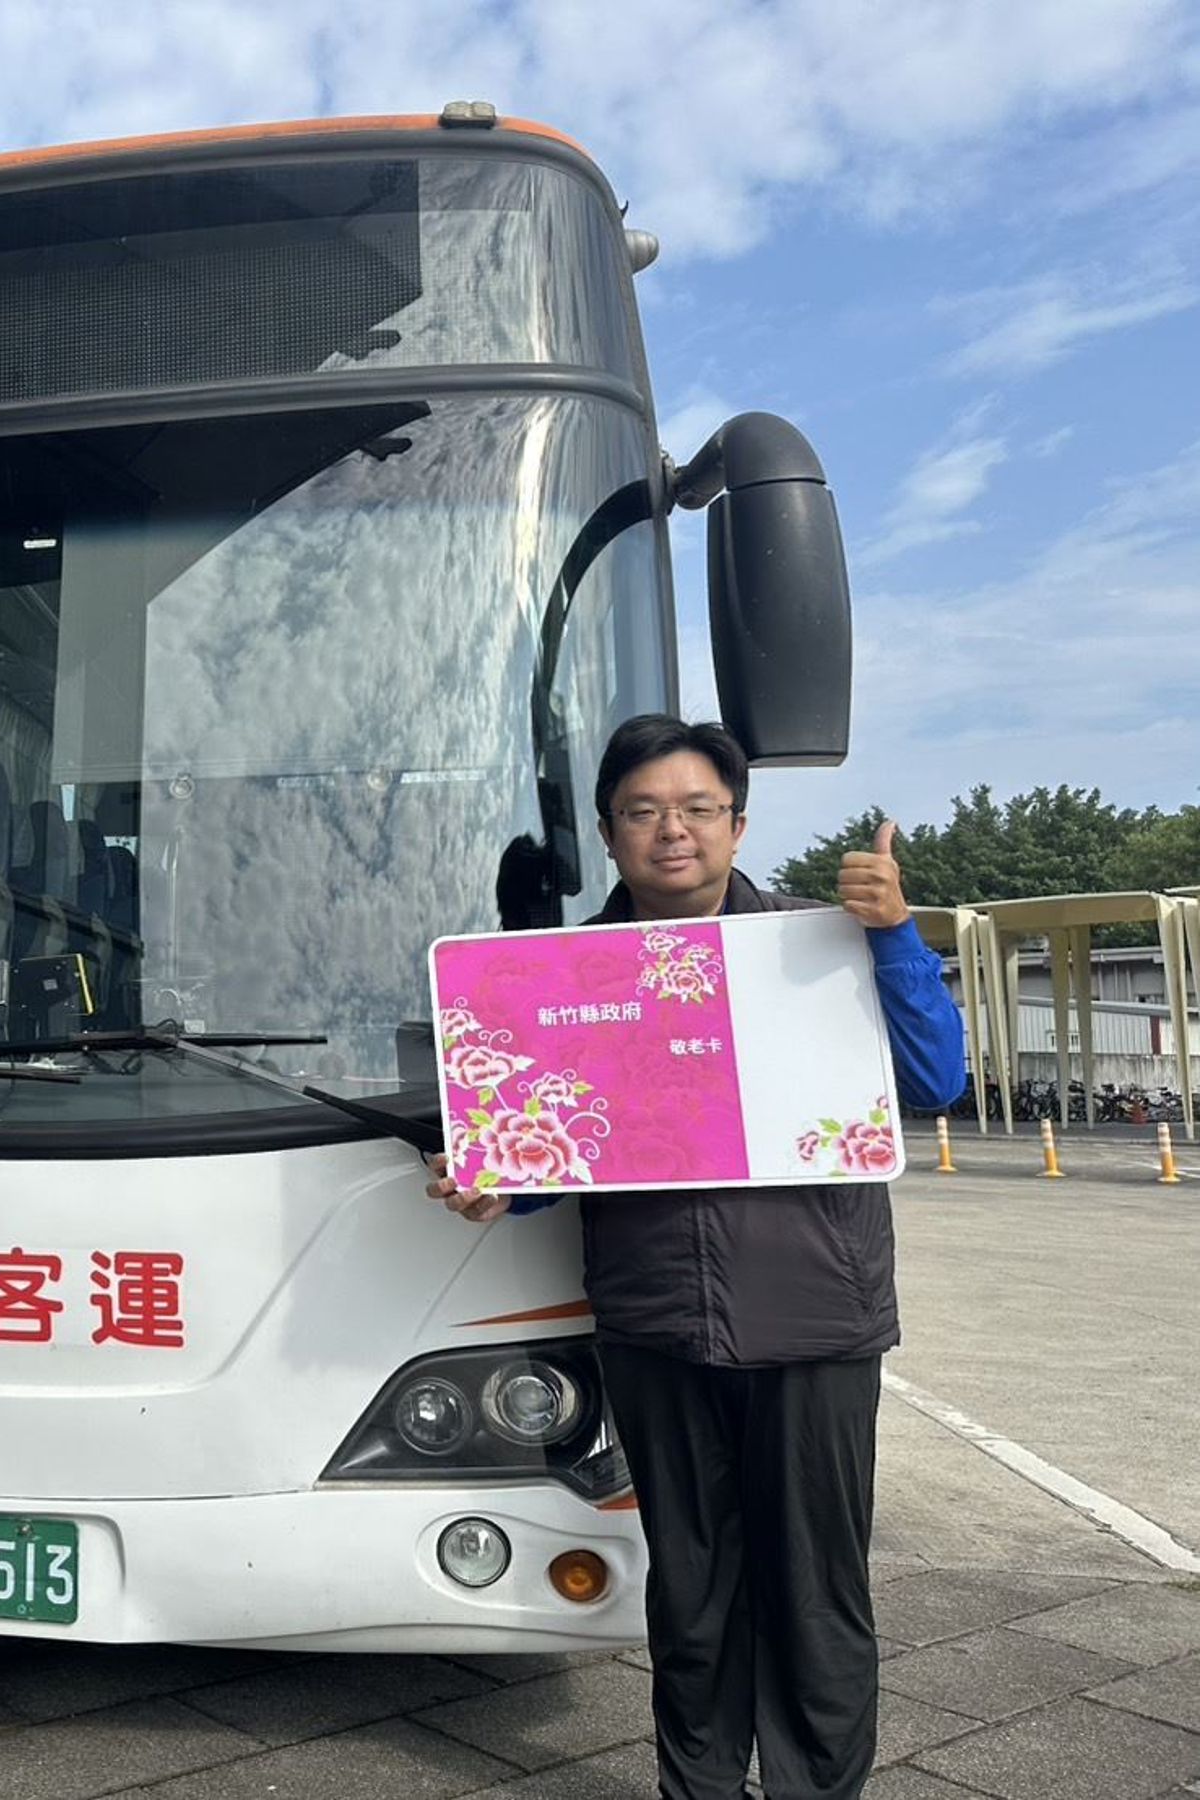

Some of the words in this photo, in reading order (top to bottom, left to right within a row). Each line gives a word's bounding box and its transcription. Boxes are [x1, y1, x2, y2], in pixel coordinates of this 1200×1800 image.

[537, 1001, 642, 1027] 新竹縣政府
[669, 1036, 723, 1055] 敬老卡
